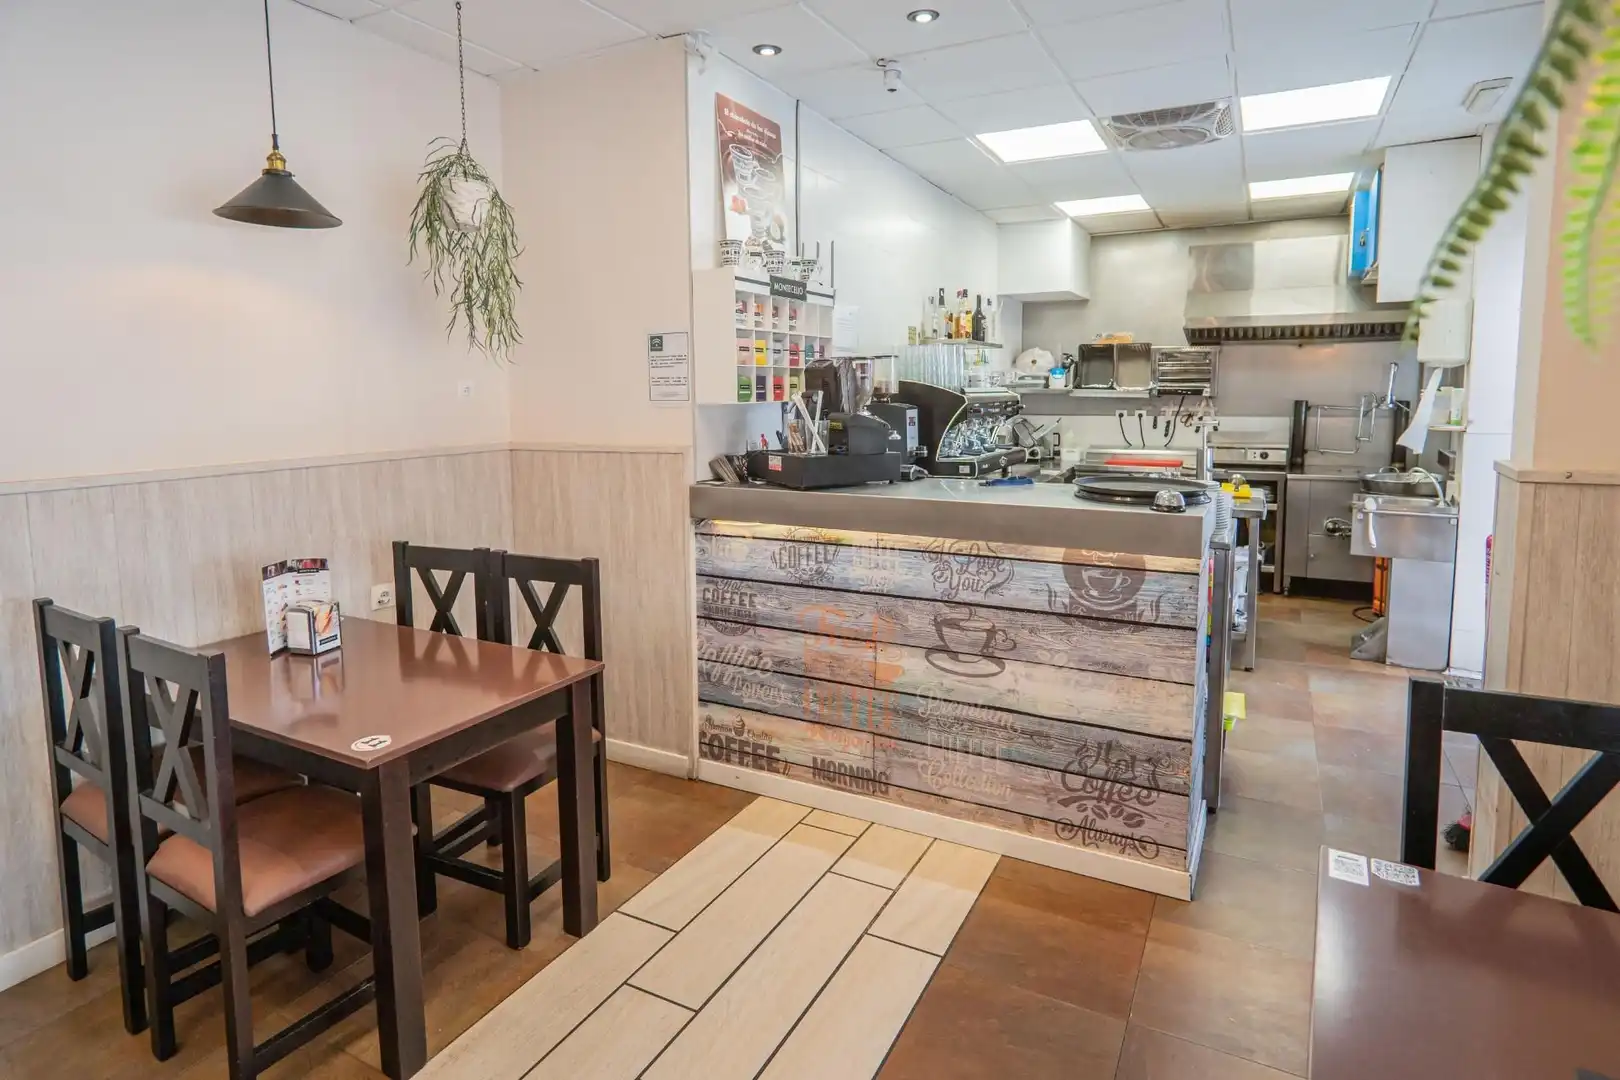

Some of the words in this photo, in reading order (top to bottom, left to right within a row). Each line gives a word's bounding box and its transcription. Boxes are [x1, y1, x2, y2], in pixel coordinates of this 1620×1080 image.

[702, 587, 758, 608] COFFEE
[933, 559, 985, 600] You
[811, 757, 889, 796] MORNING
[1061, 758, 1158, 807] Coffee
[1068, 814, 1143, 856] Always
